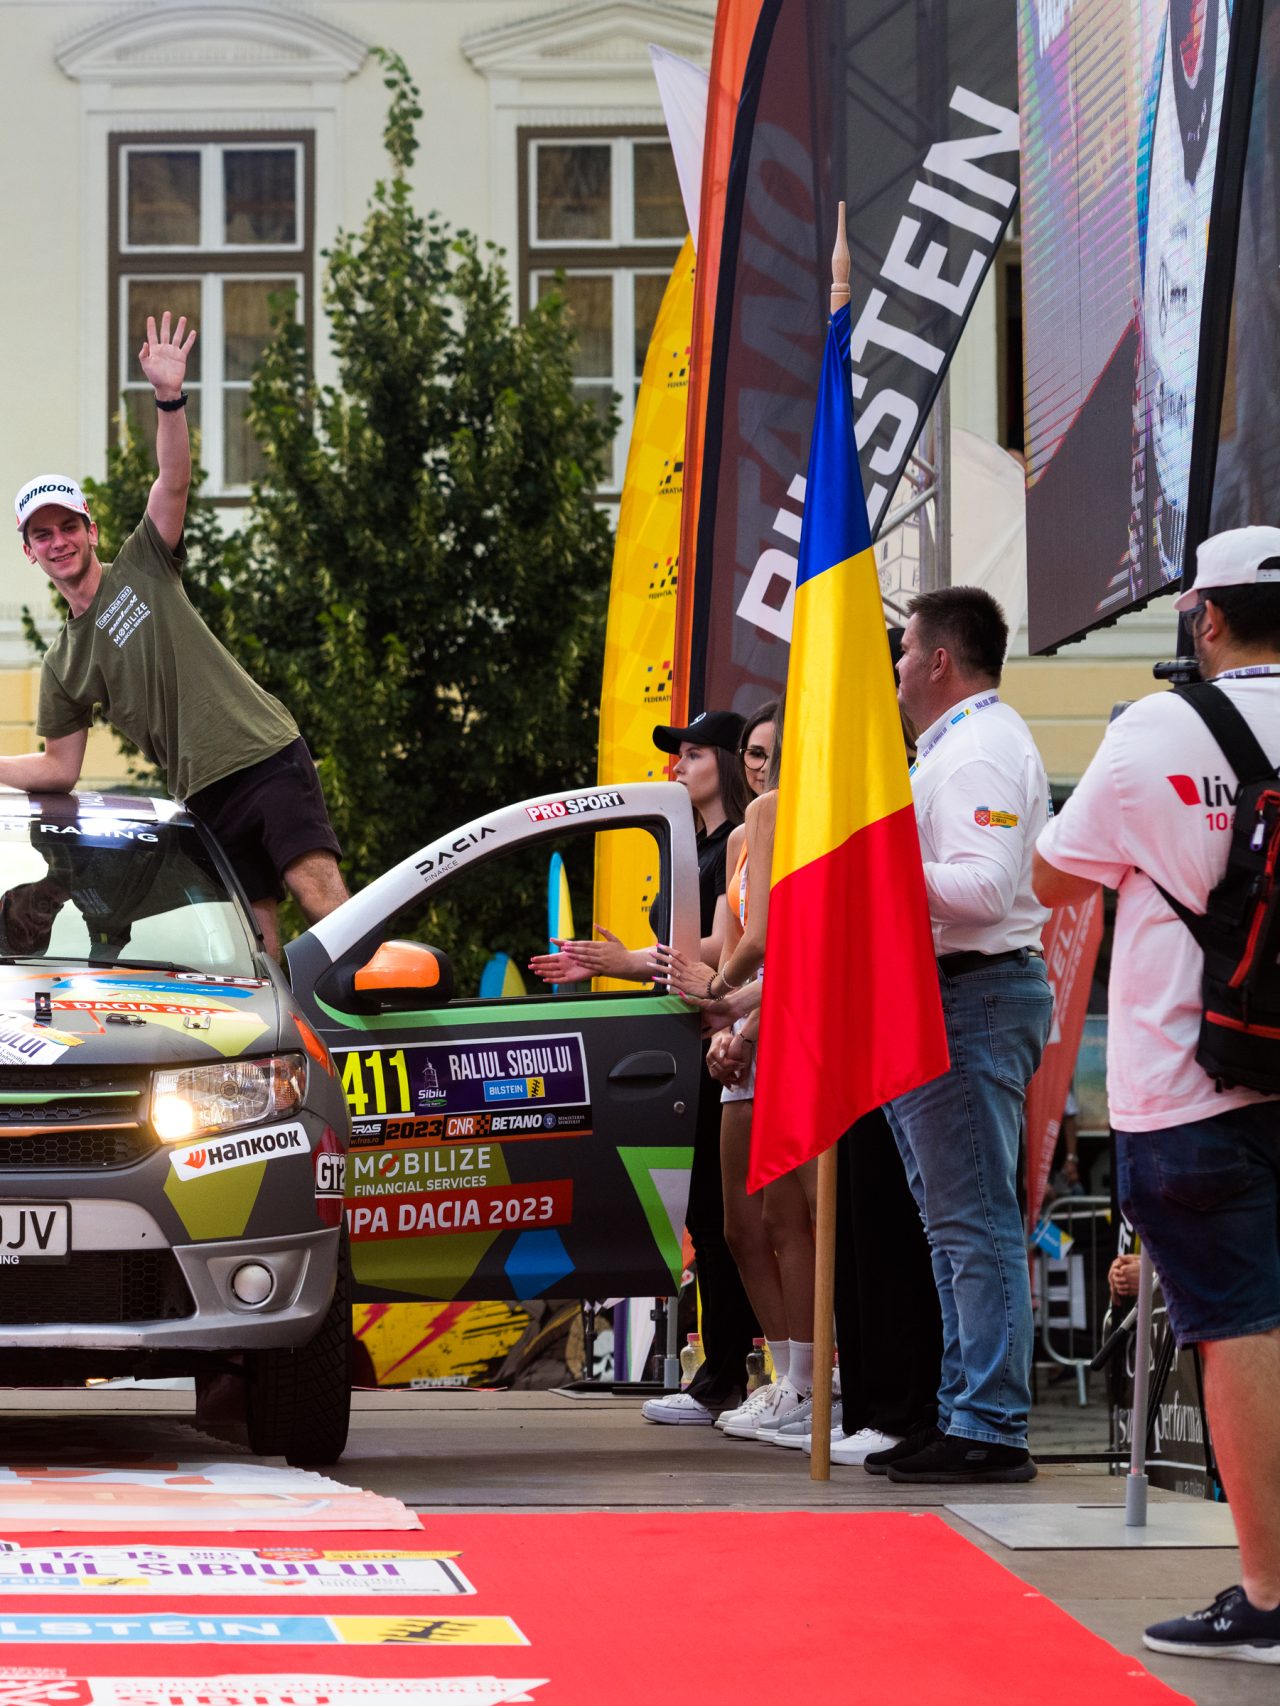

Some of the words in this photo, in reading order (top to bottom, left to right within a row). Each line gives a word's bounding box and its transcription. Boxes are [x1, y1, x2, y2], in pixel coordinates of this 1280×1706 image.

[415, 826, 497, 876] DACIA
[424, 859, 458, 884] FINANCE
[71, 1001, 159, 1012] DACIA
[448, 1051, 506, 1081] RALIUL
[506, 1046, 573, 1077] SIBIULUI
[417, 1088, 447, 1100] Sibiu
[489, 1084, 523, 1096] BILSTEIN
[386, 1119, 443, 1140] 2023
[447, 1117, 474, 1136] CNR
[491, 1114, 543, 1131] BETANO
[353, 1147, 492, 1180] MOBILIZE
[353, 1179, 423, 1197] FINANCIAL
[426, 1175, 488, 1193] SERVICES
[398, 1200, 481, 1231] DACIA
[489, 1196, 554, 1225] 2023
[136, 1562, 401, 1577] SIBIULUI
